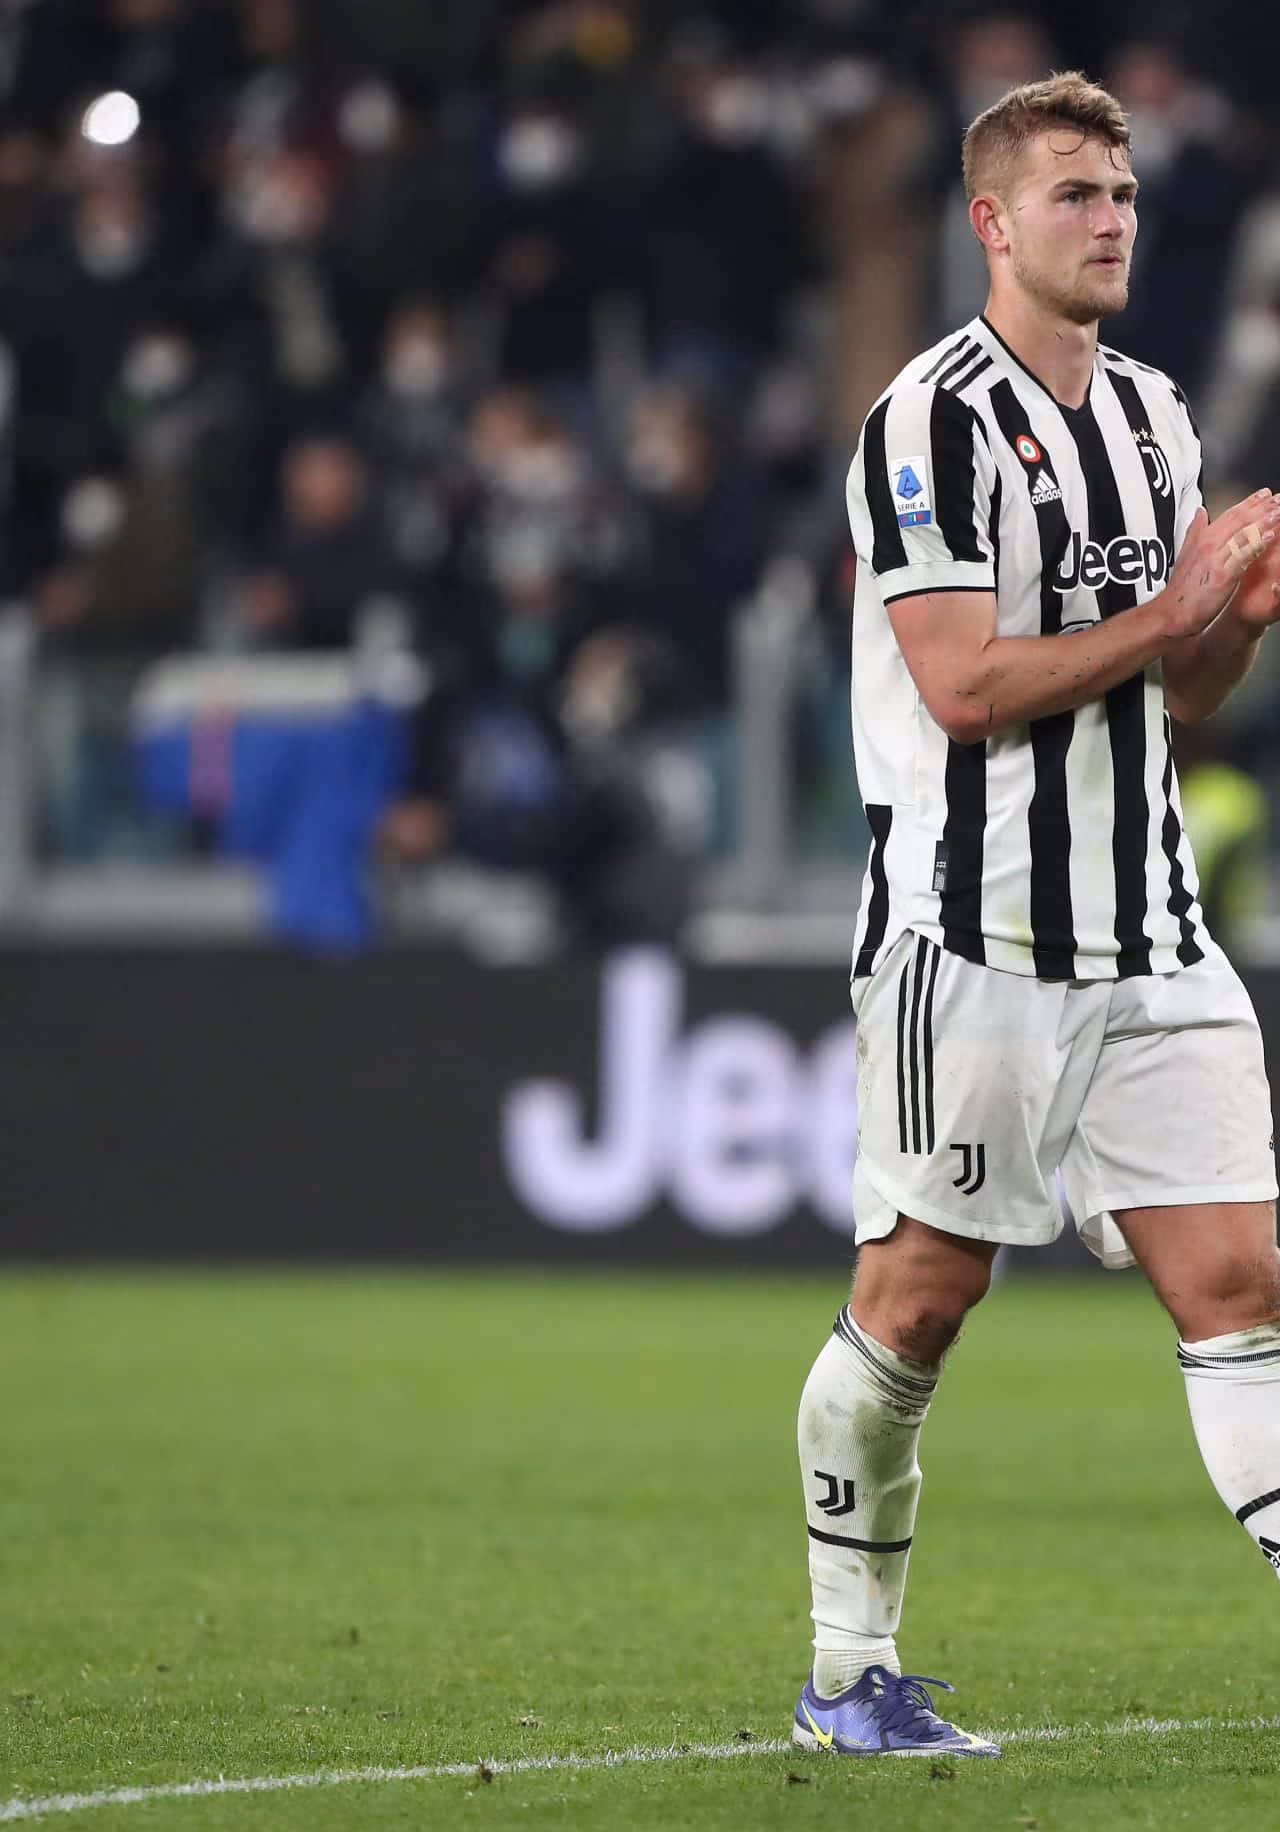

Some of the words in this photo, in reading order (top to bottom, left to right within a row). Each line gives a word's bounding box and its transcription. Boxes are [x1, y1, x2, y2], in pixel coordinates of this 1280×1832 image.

[897, 503, 917, 513] SERIE
[1031, 488, 1063, 505] adidas
[1053, 530, 1168, 593] Jeep
[505, 948, 857, 1237] Je
